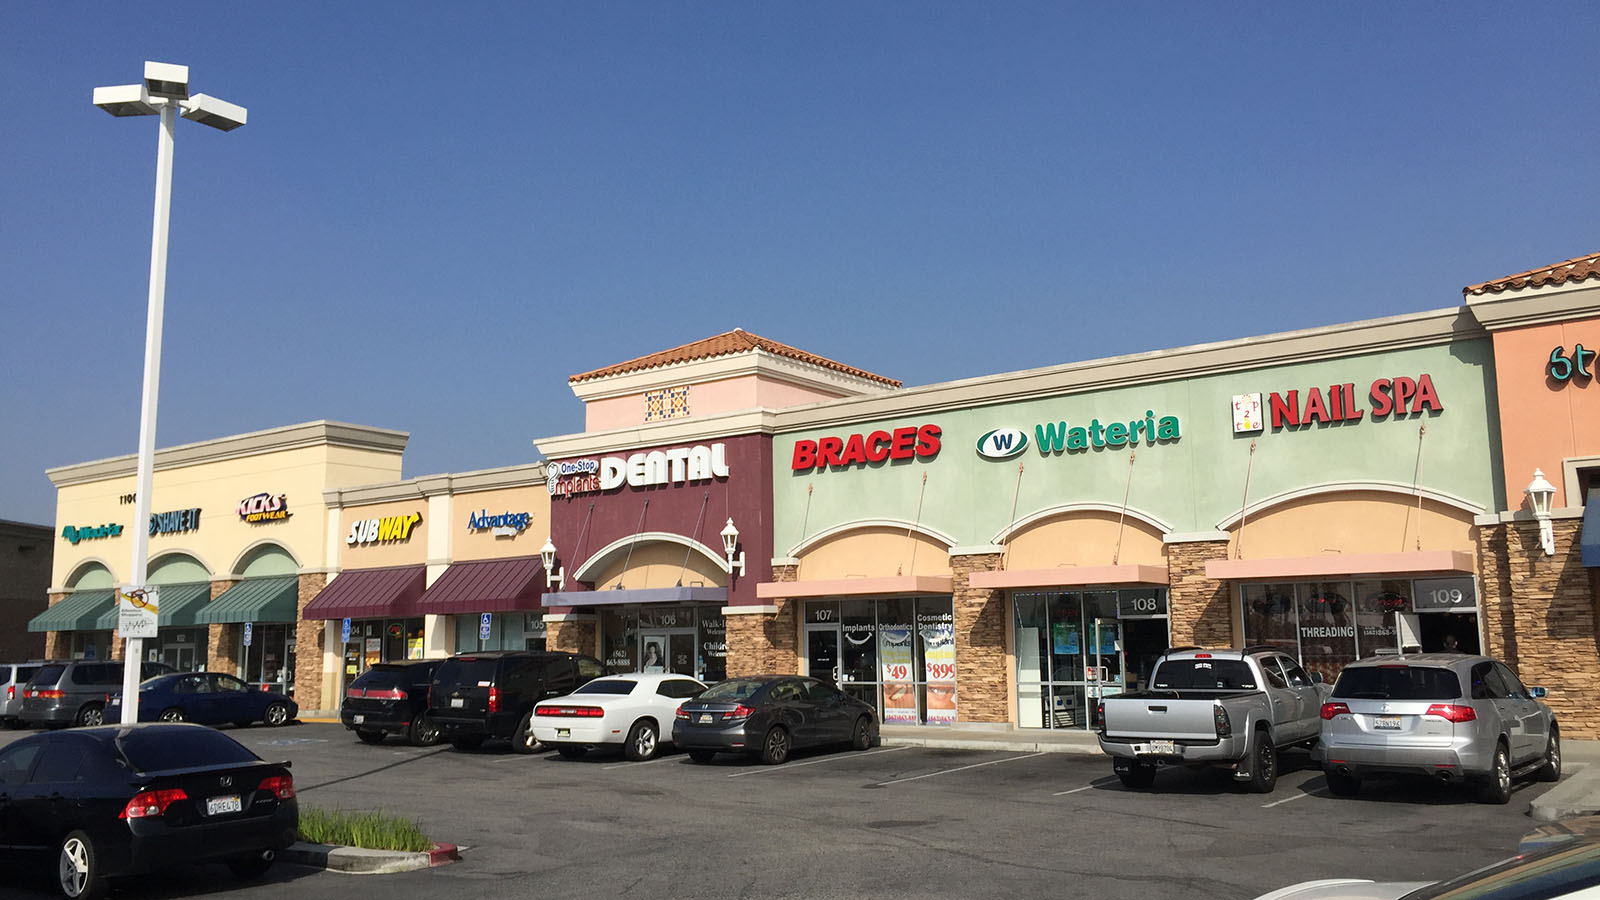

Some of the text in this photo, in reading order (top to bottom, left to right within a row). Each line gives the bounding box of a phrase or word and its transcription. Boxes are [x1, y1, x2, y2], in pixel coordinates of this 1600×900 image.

[1269, 374, 1442, 428] NAIL SPA
[993, 410, 1181, 453] W Wateria
[792, 424, 942, 470] BRACES
[561, 461, 595, 474] One-Stop
[601, 443, 729, 490] DENTAL
[236, 494, 283, 515] KICKS
[157, 509, 186, 533] SHAVE
[187, 508, 199, 530] IT
[246, 511, 286, 522] FOOTWEAR
[467, 509, 530, 531] Advantage
[346, 511, 420, 544] SUBWAY
[1429, 589, 1462, 604] 109
[1131, 598, 1157, 611] 108
[660, 615, 677, 625] 106
[815, 610, 832, 621] 107
[917, 613, 953, 622] Cosmetic
[531, 620, 545, 630] 105
[702, 619, 725, 628] Walk-I
[842, 624, 875, 633] Implants
[879, 623, 913, 631] Orthodontics
[918, 622, 953, 633] Dentistry
[349, 626, 360, 635] 04
[1301, 627, 1354, 638] THREADING
[886, 664, 907, 679] $49
[927, 662, 956, 679] $899
